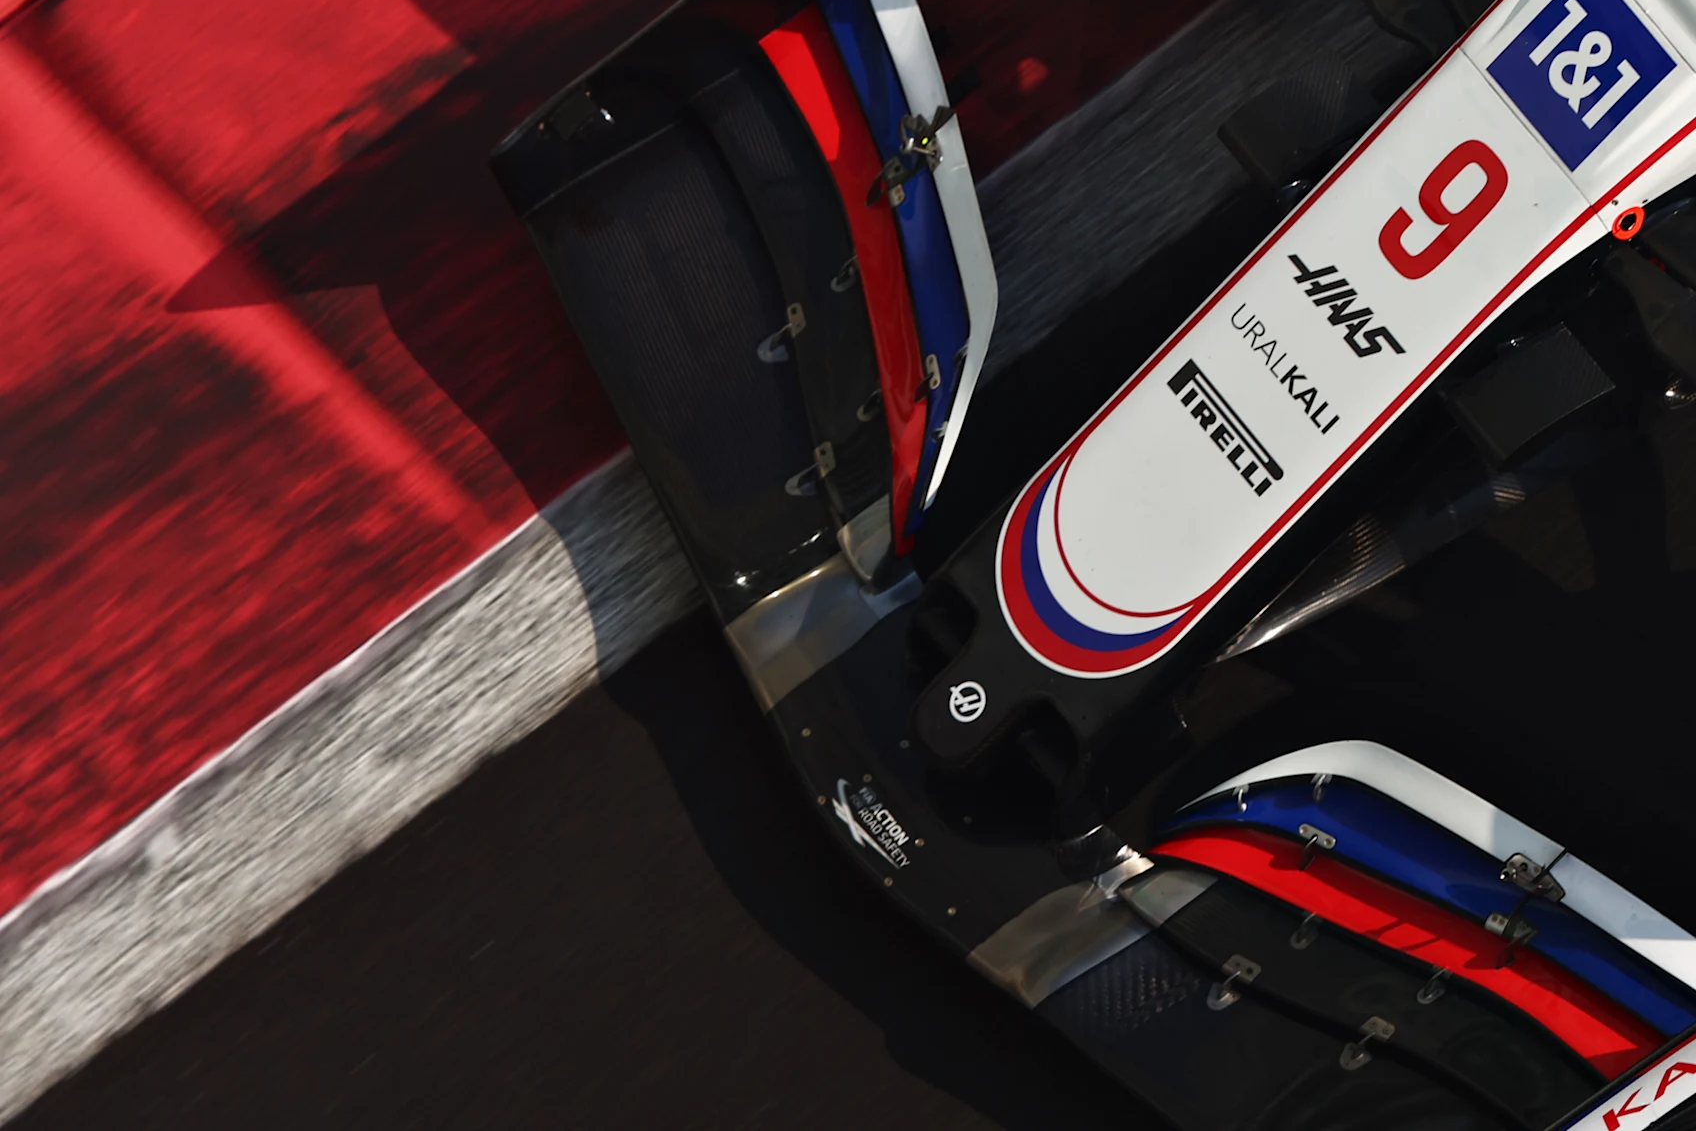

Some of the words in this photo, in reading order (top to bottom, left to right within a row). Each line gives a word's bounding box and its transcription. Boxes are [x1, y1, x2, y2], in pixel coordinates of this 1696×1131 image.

[1378, 139, 1509, 280] 9
[1287, 254, 1406, 357] HAAS
[1167, 358, 1284, 497] PIRELLI
[1231, 302, 1340, 435] URALKALI
[857, 806, 883, 836] ROAD
[877, 831, 911, 868] SAFETY
[869, 802, 910, 847] ACTION
